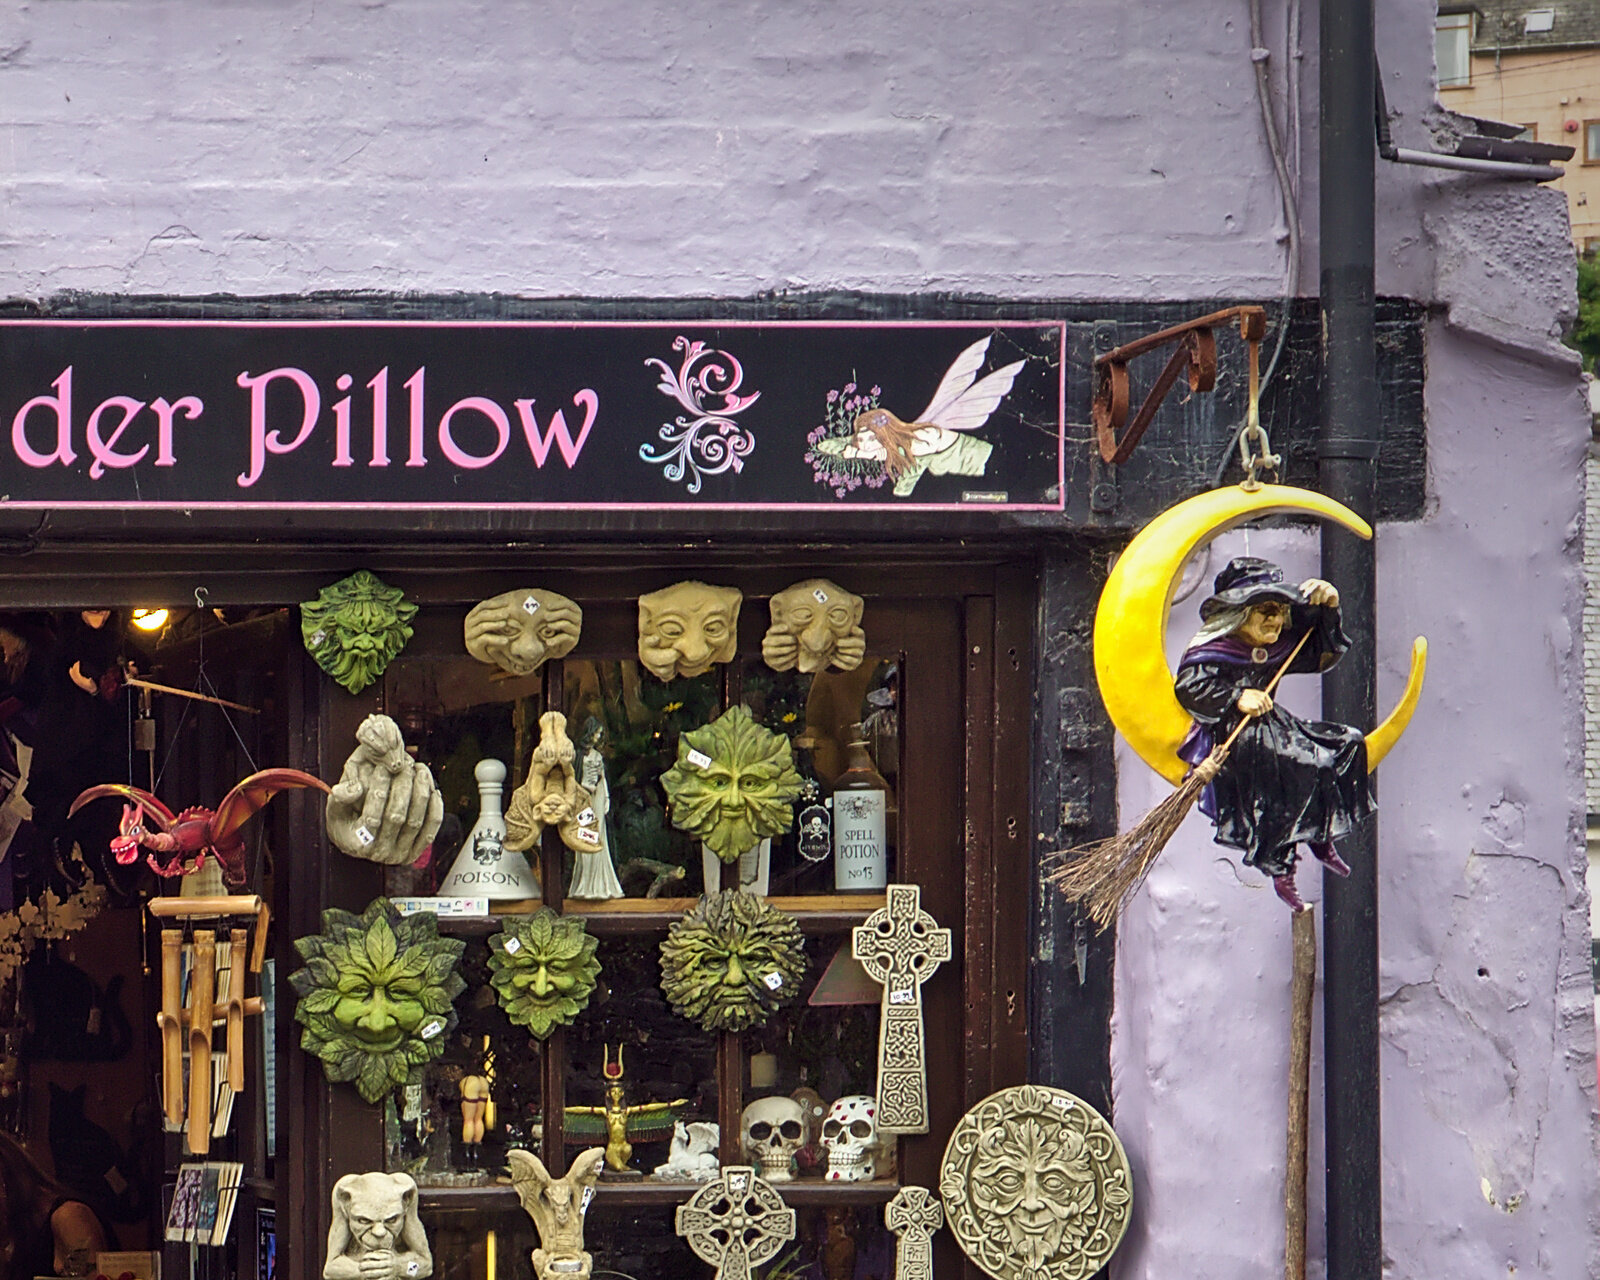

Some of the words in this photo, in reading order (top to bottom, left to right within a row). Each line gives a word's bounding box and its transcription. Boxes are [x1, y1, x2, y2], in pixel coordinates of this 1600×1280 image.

[236, 364, 599, 488] Pillow
[845, 830, 875, 840] SPELL
[840, 844, 879, 859] POTION
[453, 872, 520, 887] POISON
